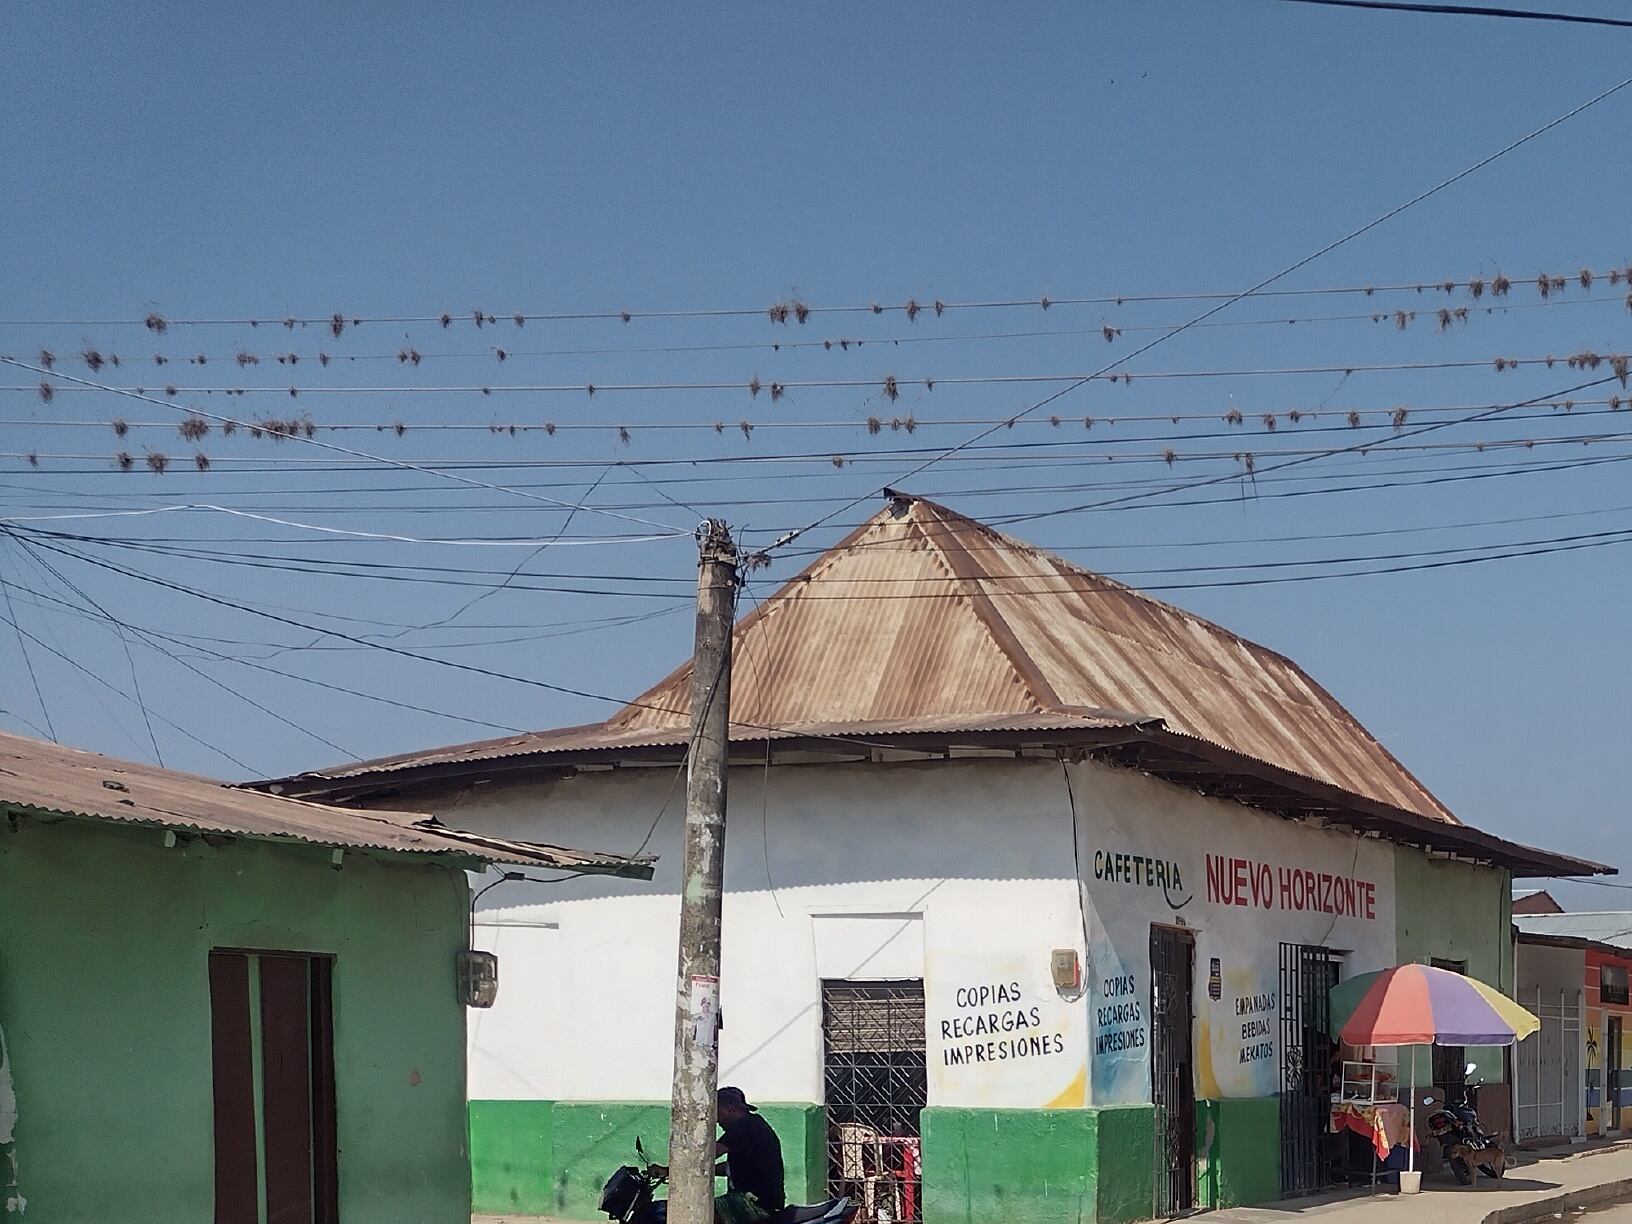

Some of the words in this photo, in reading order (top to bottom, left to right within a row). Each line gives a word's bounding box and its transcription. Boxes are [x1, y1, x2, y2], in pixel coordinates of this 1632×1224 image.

[1094, 849, 1193, 910] CAFETERIA
[1205, 853, 1274, 910] NUEVO
[1278, 866, 1376, 920] HORIZONTE
[956, 981, 1022, 1008] COPIAS
[1103, 974, 1135, 998] COPIAS
[1097, 1001, 1140, 1028] RECARGAS
[1235, 992, 1276, 1016] EMPANADAS
[941, 1006, 1041, 1040] RECARGAS
[1241, 1018, 1271, 1040] BEBIDAS
[944, 1033, 1064, 1066] IMPRESIONES
[1095, 1027, 1145, 1056] IMPRESIONES
[1239, 1041, 1273, 1065] MEKATOS
